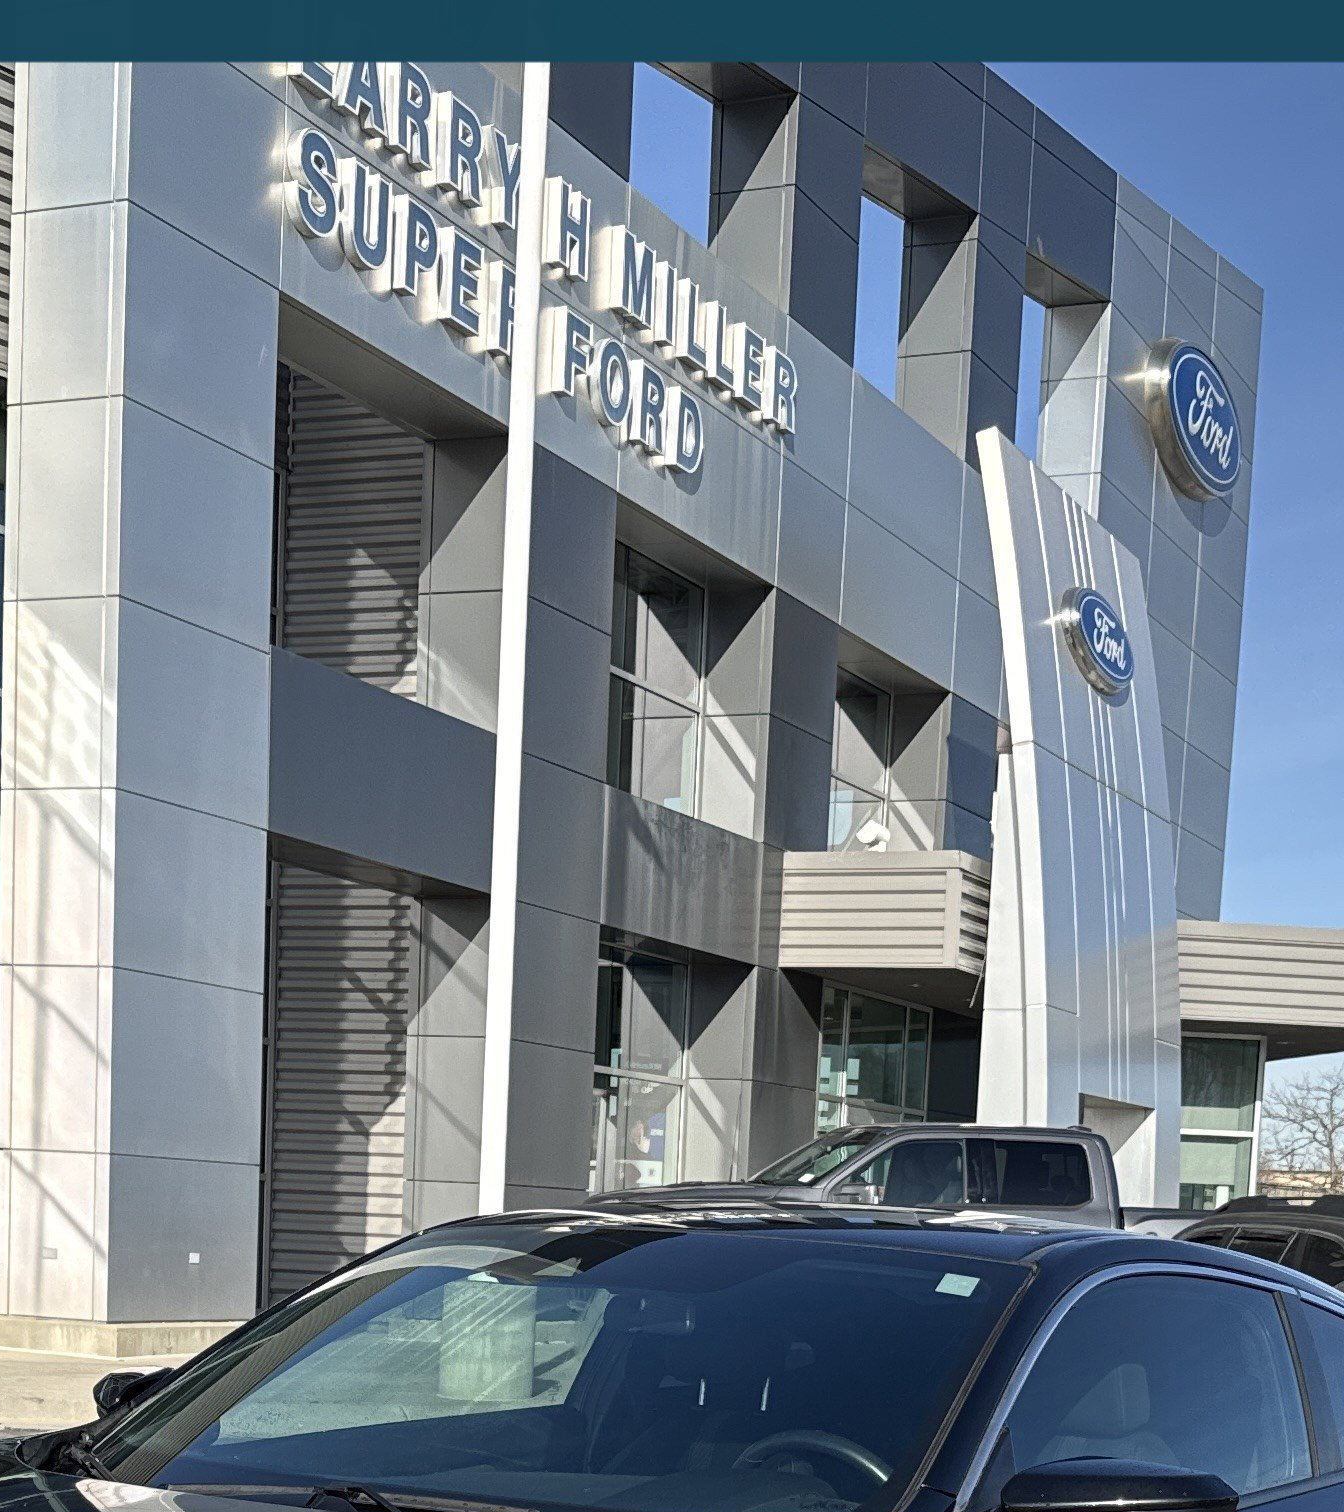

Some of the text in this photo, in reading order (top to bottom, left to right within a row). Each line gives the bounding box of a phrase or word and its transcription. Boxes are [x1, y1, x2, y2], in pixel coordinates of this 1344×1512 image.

[544, 176, 591, 281] H
[609, 225, 797, 433] MILLER
[551, 305, 704, 474] FORD
[1187, 370, 1234, 470] Ford
[1093, 607, 1127, 671] Ford
